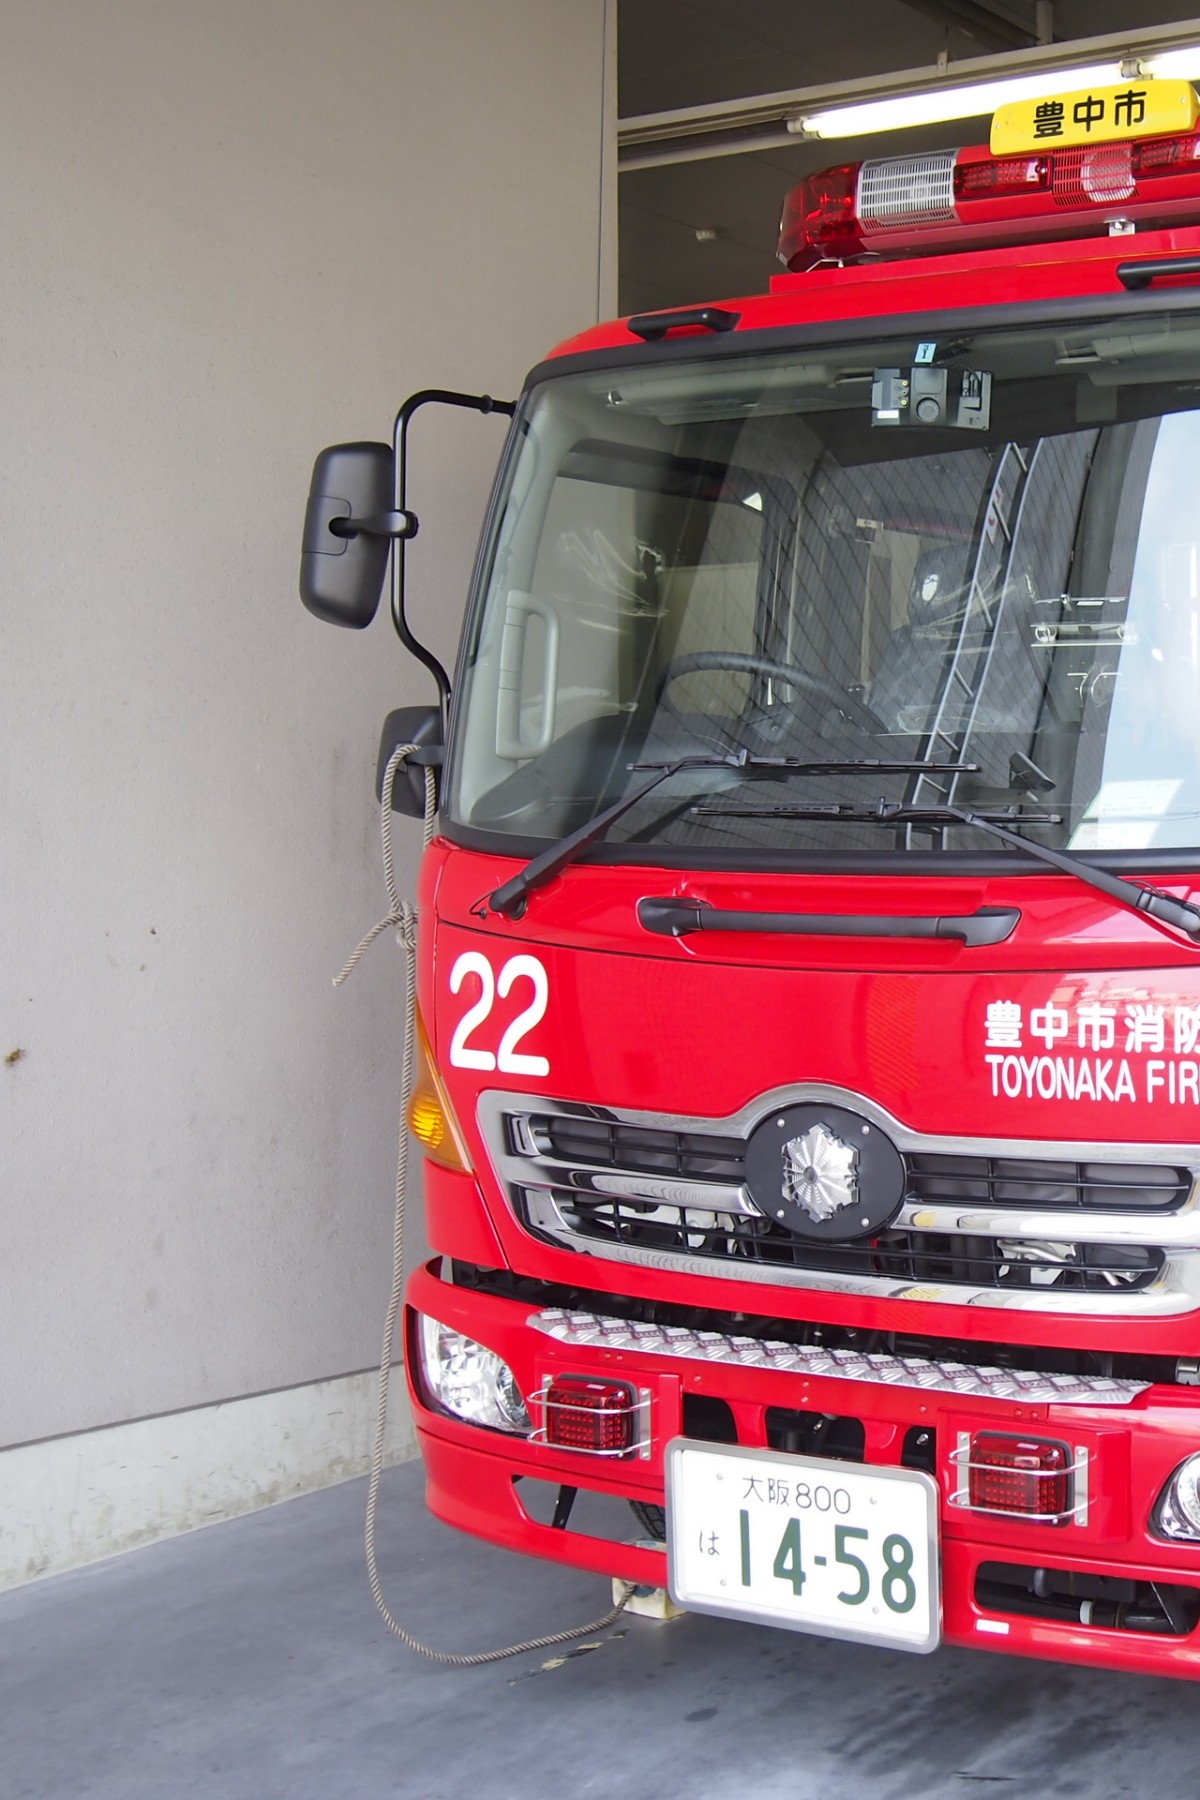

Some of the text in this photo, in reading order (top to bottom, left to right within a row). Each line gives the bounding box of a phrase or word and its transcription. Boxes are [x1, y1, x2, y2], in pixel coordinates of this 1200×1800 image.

[1033, 89, 1147, 139] 豊中市
[449, 951, 550, 1077] 22
[984, 1054, 1137, 1103] TOYONAKA
[699, 1508, 917, 1615] は 14-58
